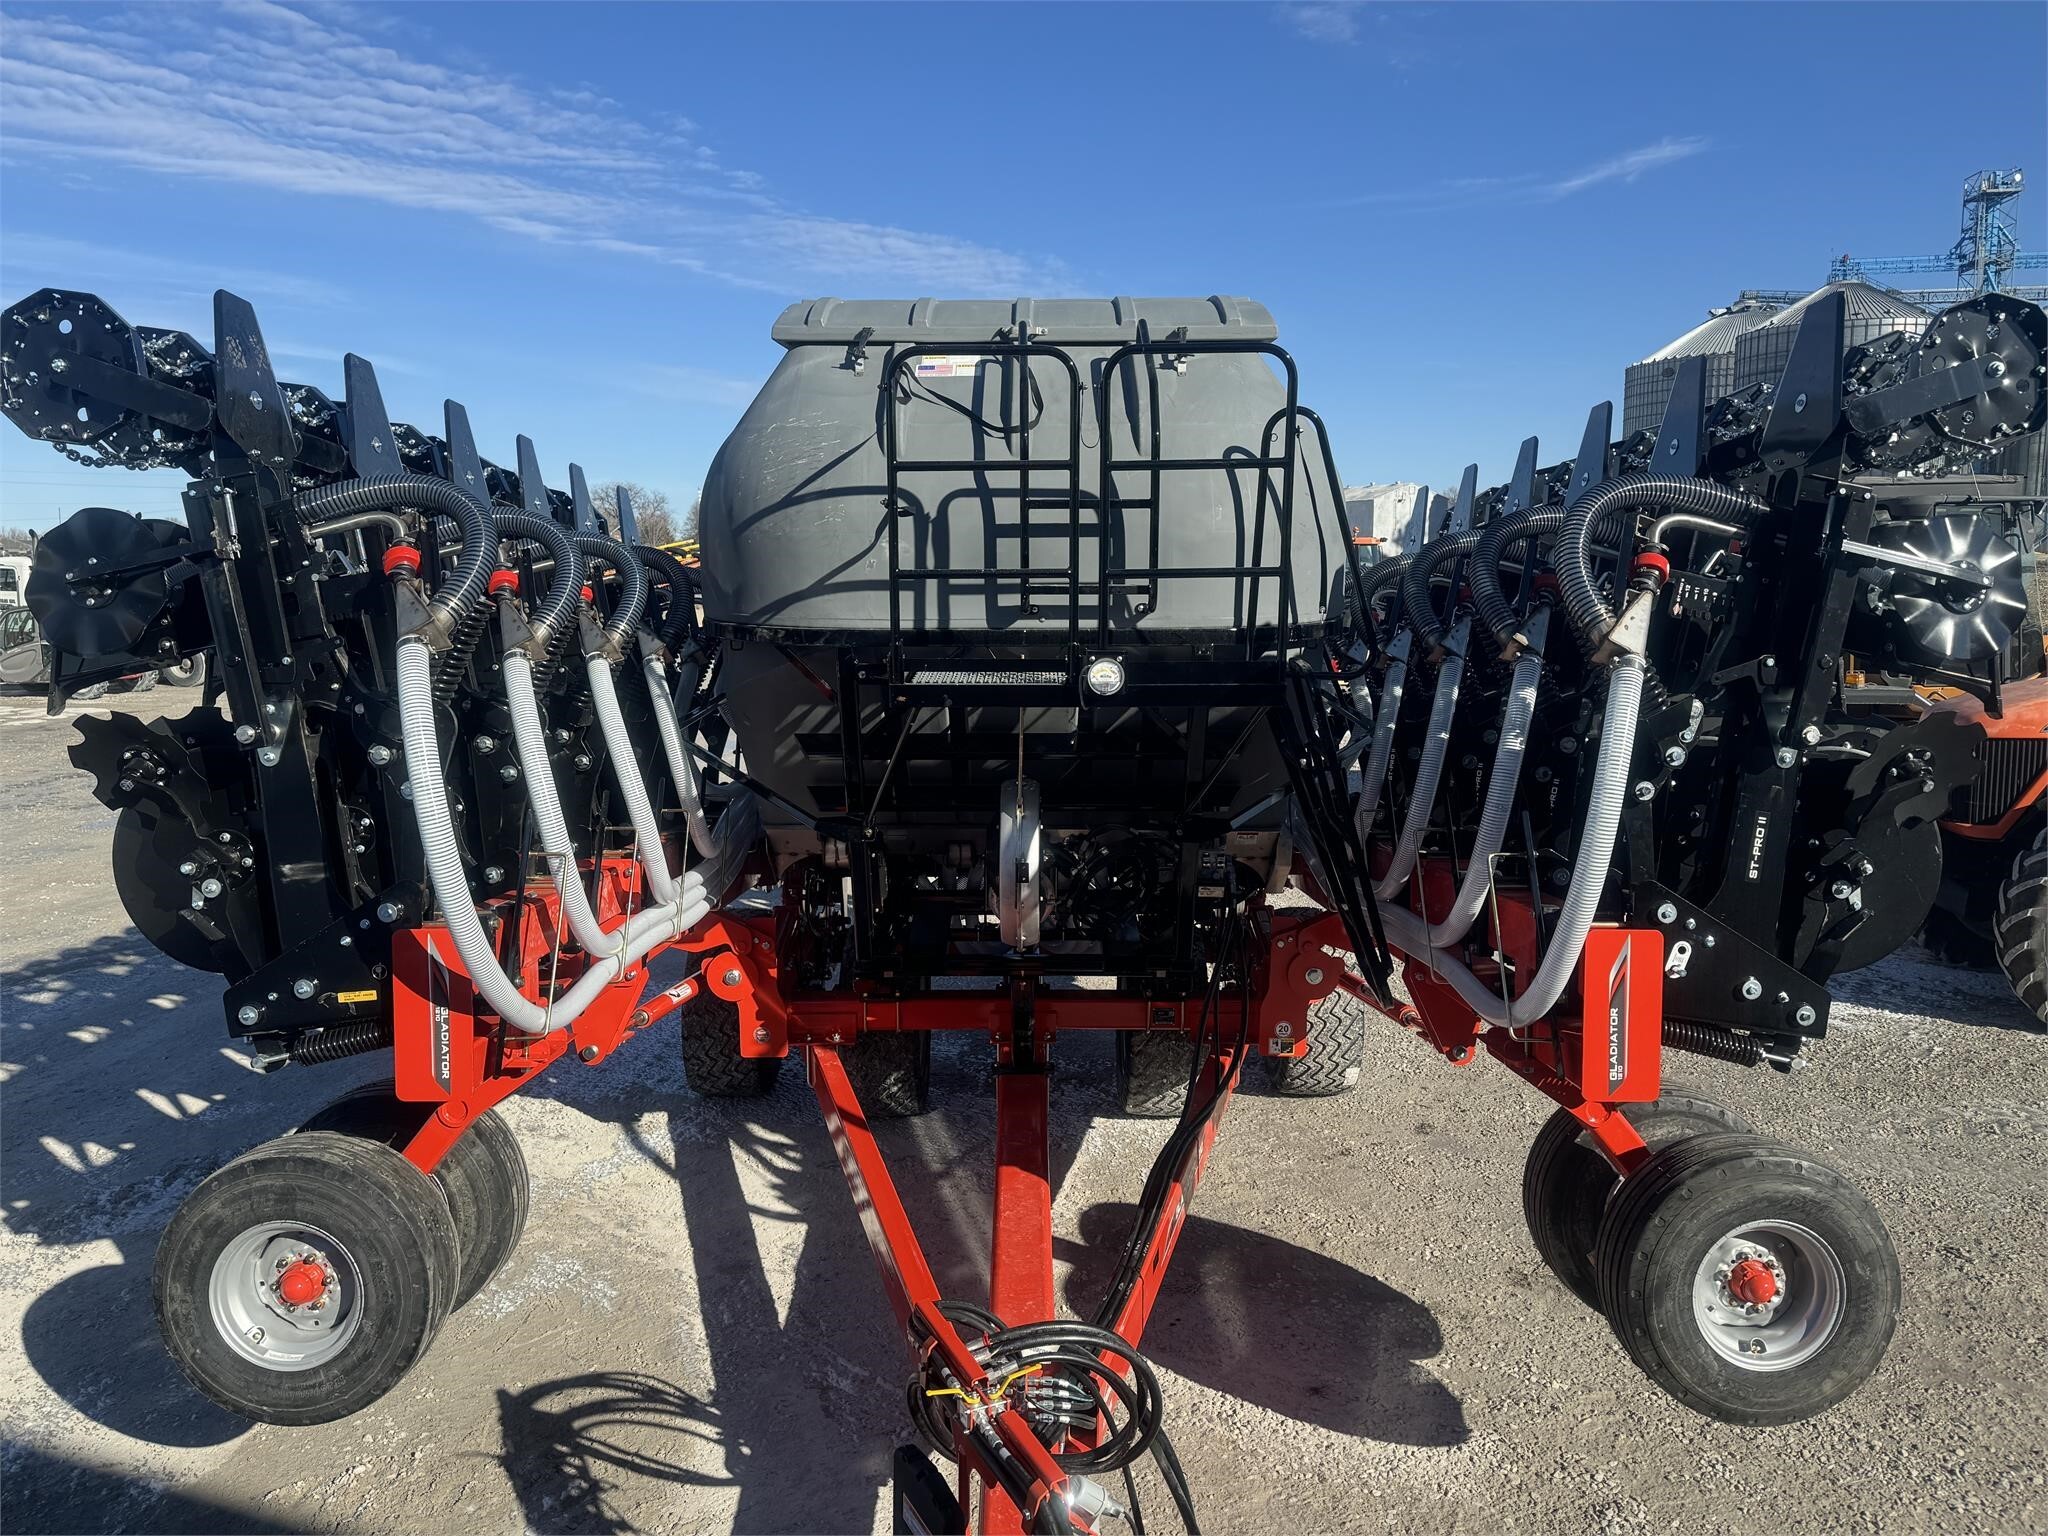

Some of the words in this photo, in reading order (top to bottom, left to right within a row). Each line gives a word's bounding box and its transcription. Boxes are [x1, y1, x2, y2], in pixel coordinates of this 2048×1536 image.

[440, 1006, 450, 1079] GLADIATOR
[1278, 1024, 1289, 1033] 20
[1609, 1008, 1619, 1081] GLADIATOR
